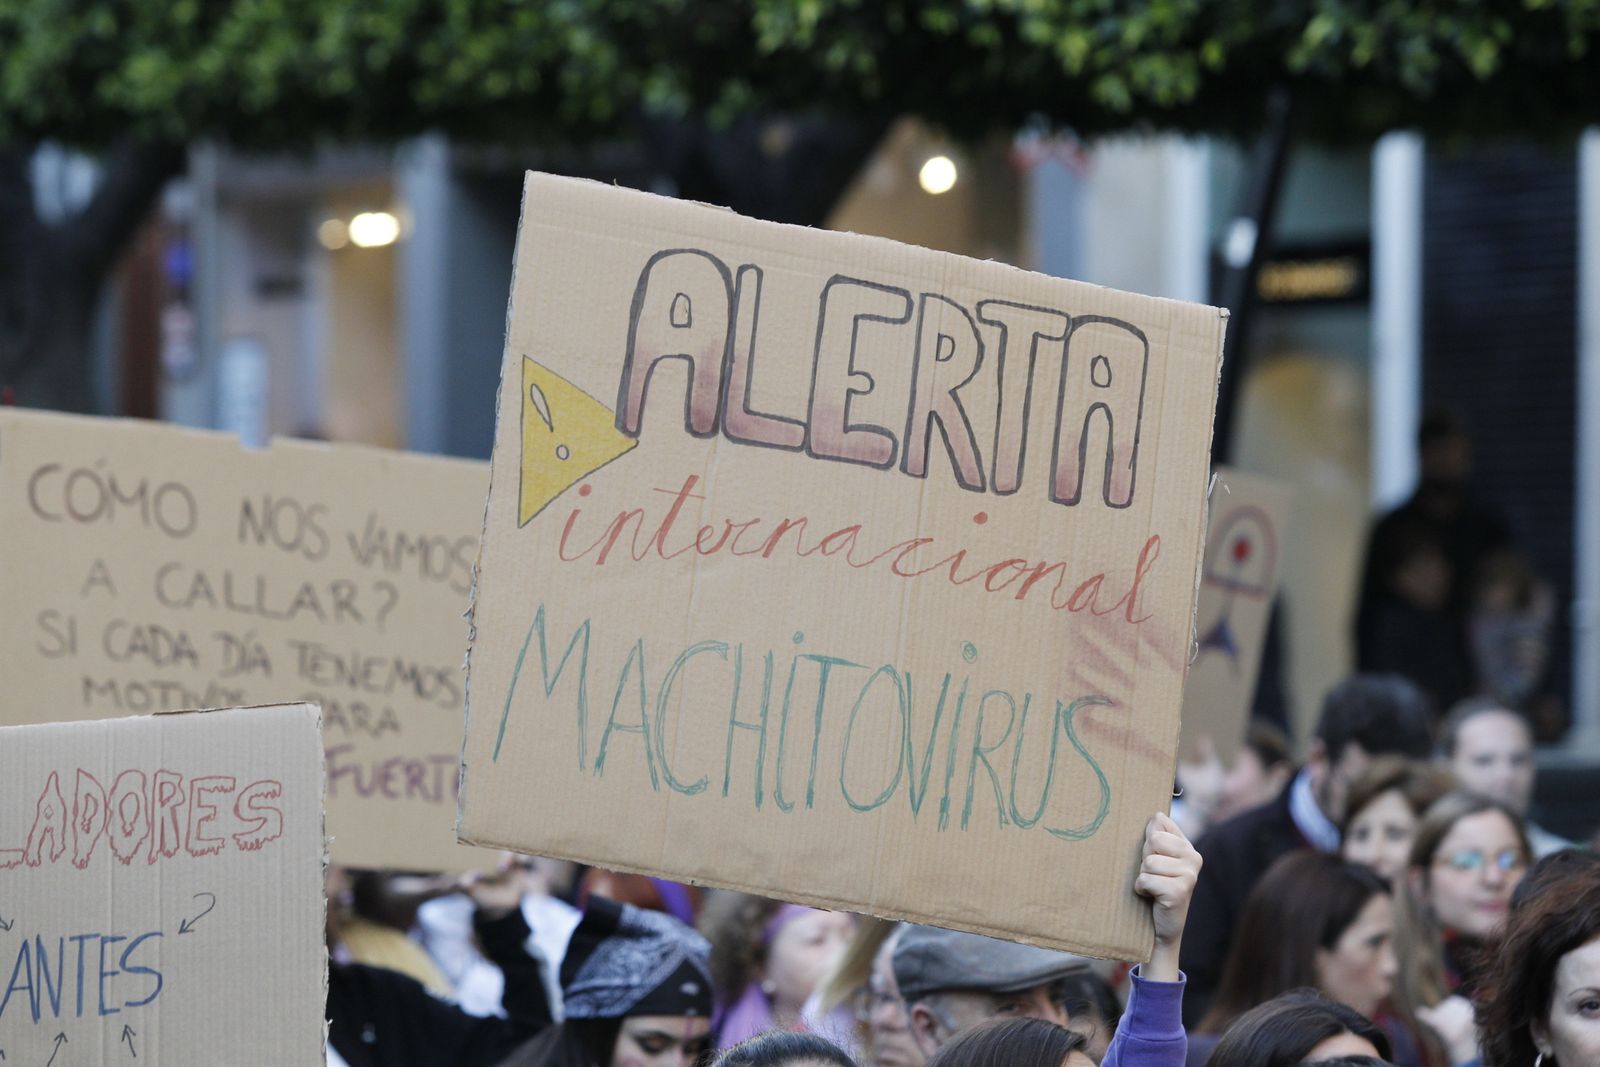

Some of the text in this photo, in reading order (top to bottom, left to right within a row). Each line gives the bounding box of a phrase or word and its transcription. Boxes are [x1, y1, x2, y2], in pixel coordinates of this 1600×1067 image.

[614, 248, 1149, 509] ALERTA
[239, 494, 330, 562] NOS
[346, 512, 481, 595] VAMOS
[558, 474, 1162, 625] internacional
[81, 559, 400, 632] A CALLAR?
[36, 608, 78, 659] SI
[103, 619, 199, 671] CADA
[288, 637, 462, 709] TENEMOS
